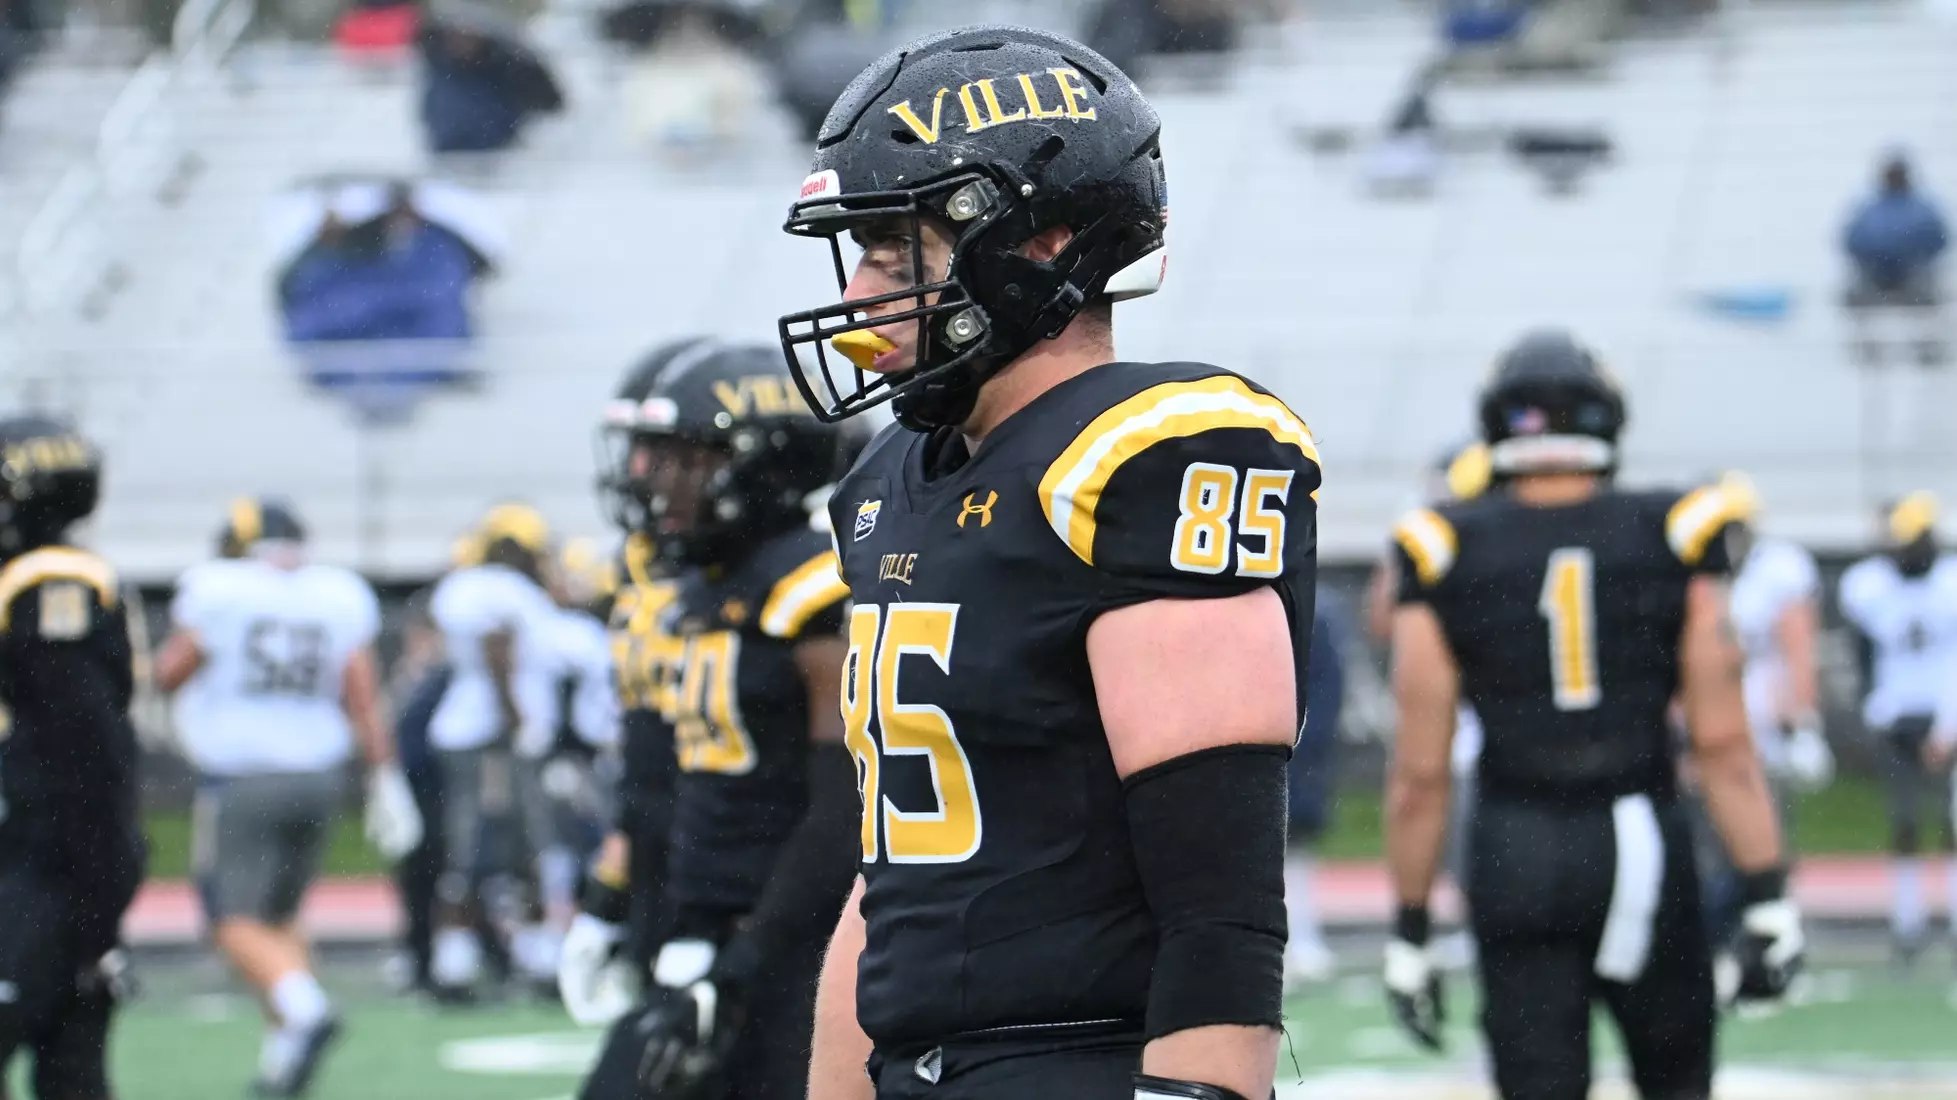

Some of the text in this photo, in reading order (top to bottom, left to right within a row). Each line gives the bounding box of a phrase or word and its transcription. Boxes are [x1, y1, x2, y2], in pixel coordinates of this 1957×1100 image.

[887, 67, 1097, 144] VILLE
[878, 552, 919, 586] VILLE
[1169, 462, 1295, 579] 85
[1538, 547, 1603, 711] 1
[841, 602, 982, 864] 85
